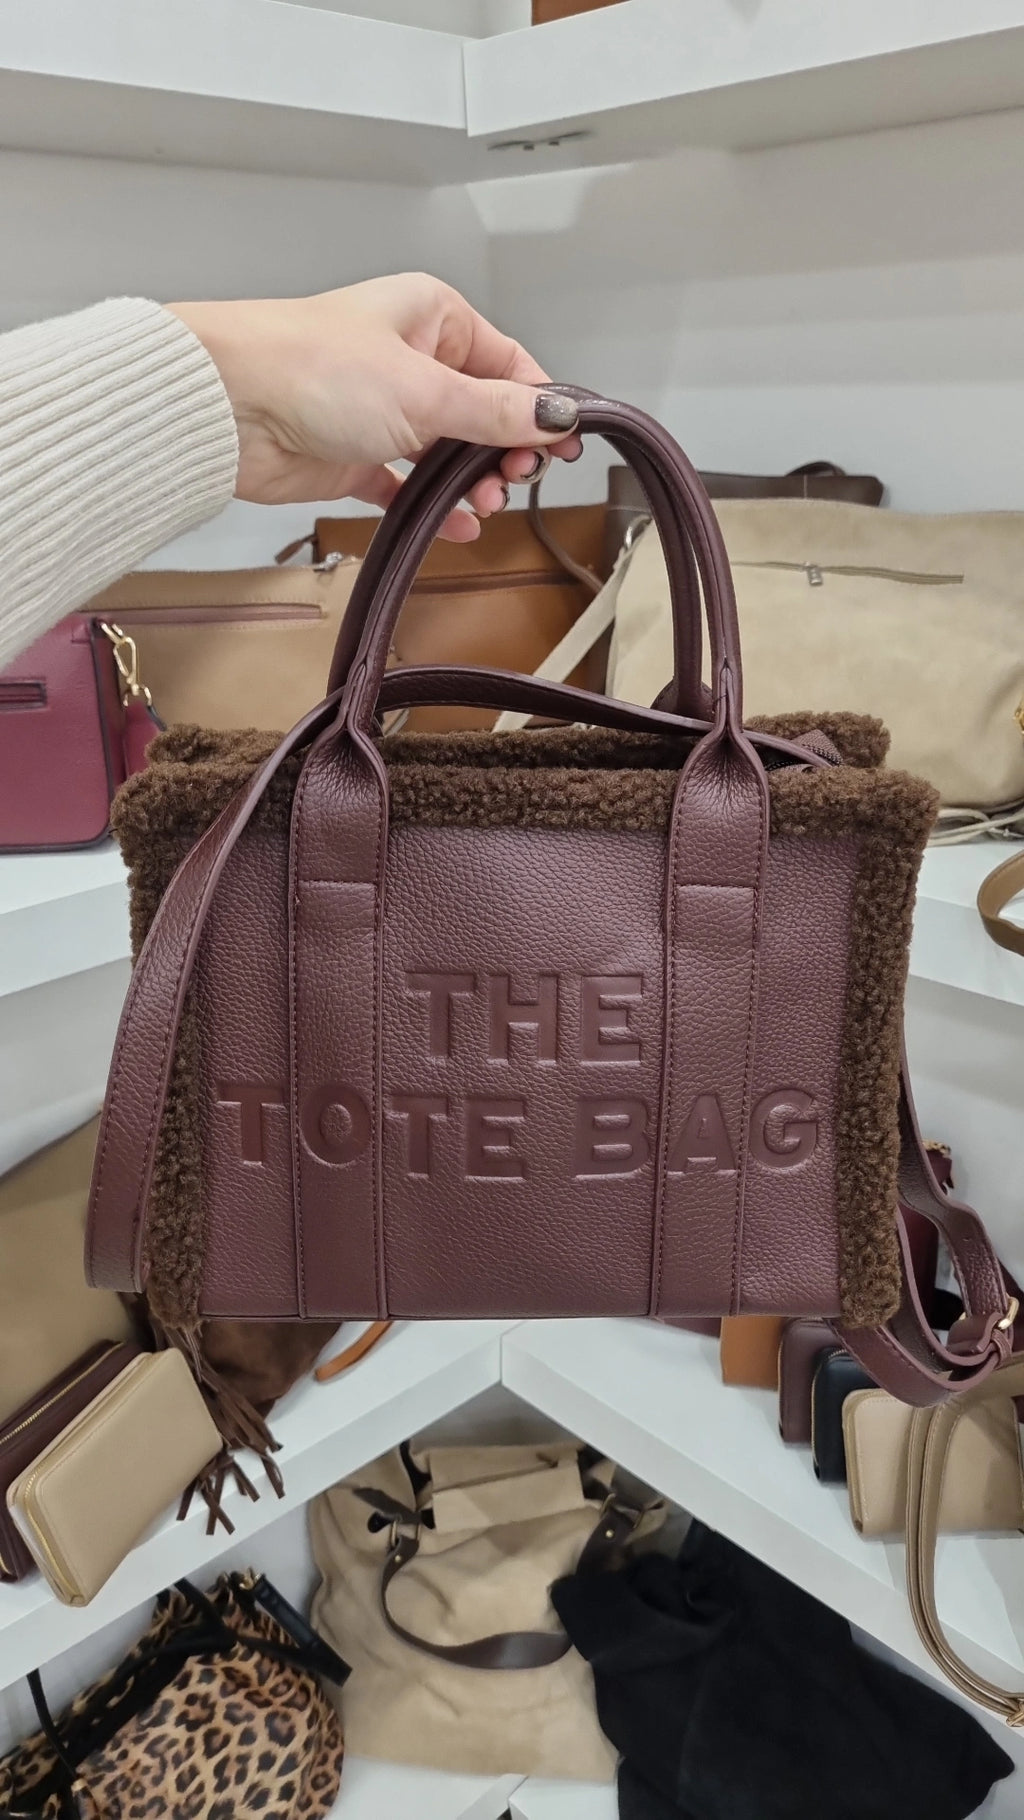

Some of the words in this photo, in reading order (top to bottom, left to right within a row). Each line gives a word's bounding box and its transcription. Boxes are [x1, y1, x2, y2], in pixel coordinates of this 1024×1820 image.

[405, 972, 644, 1068] THE
[216, 1083, 527, 1183] TOTE
[573, 1089, 818, 1182] BAG
